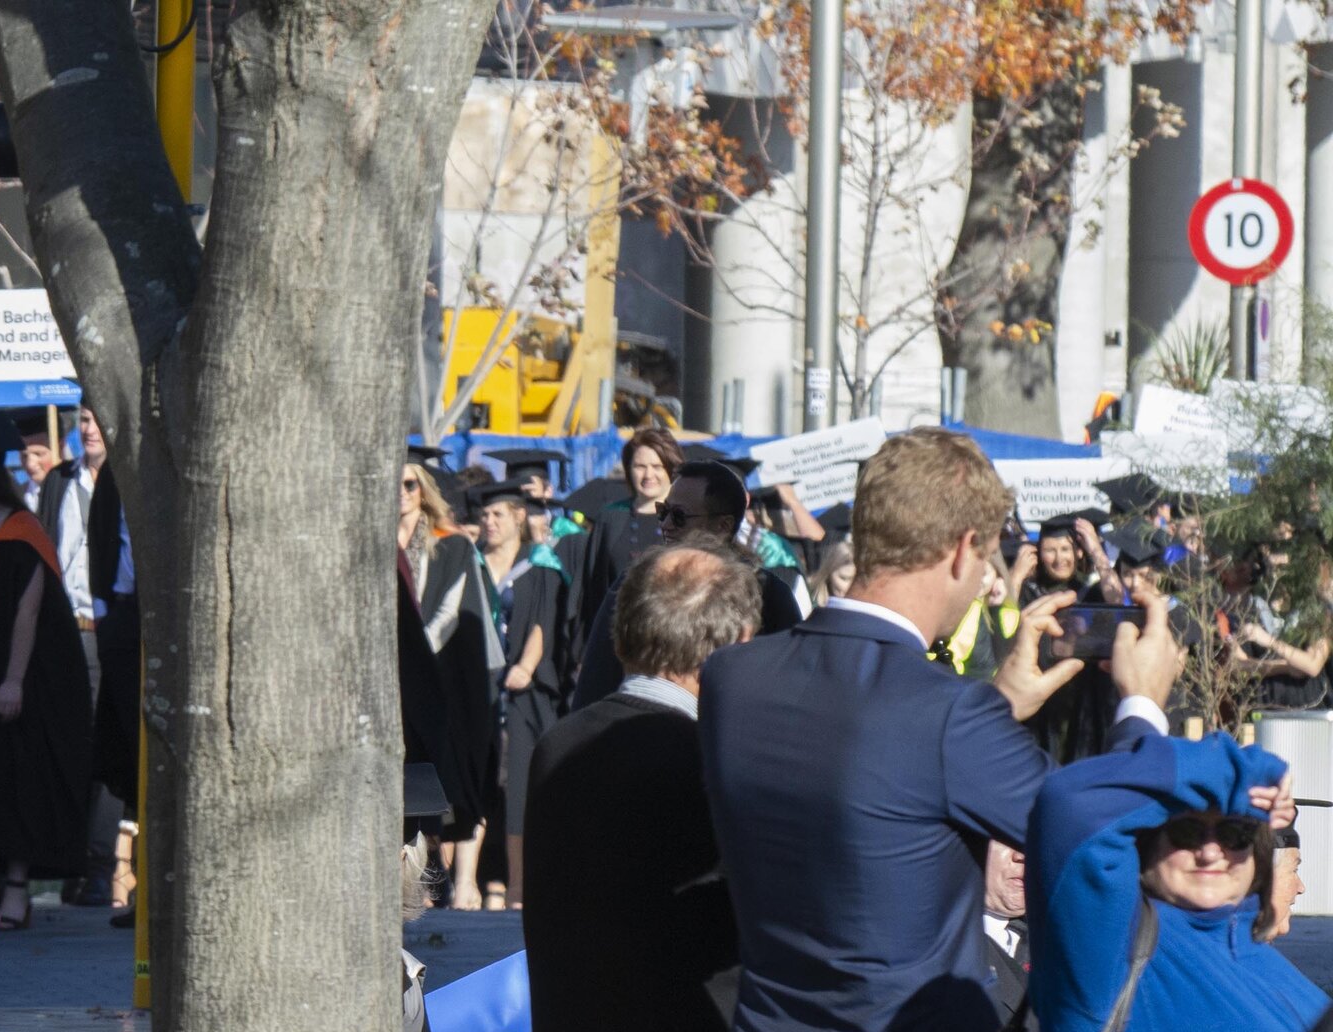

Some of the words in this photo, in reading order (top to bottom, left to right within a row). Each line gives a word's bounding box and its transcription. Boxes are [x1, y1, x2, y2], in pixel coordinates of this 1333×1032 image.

[1224, 212, 1263, 248] 10
[20, 329, 48, 343] and
[1023, 476, 1082, 488] Bachelor
[1021, 491, 1090, 503] Viticulture
